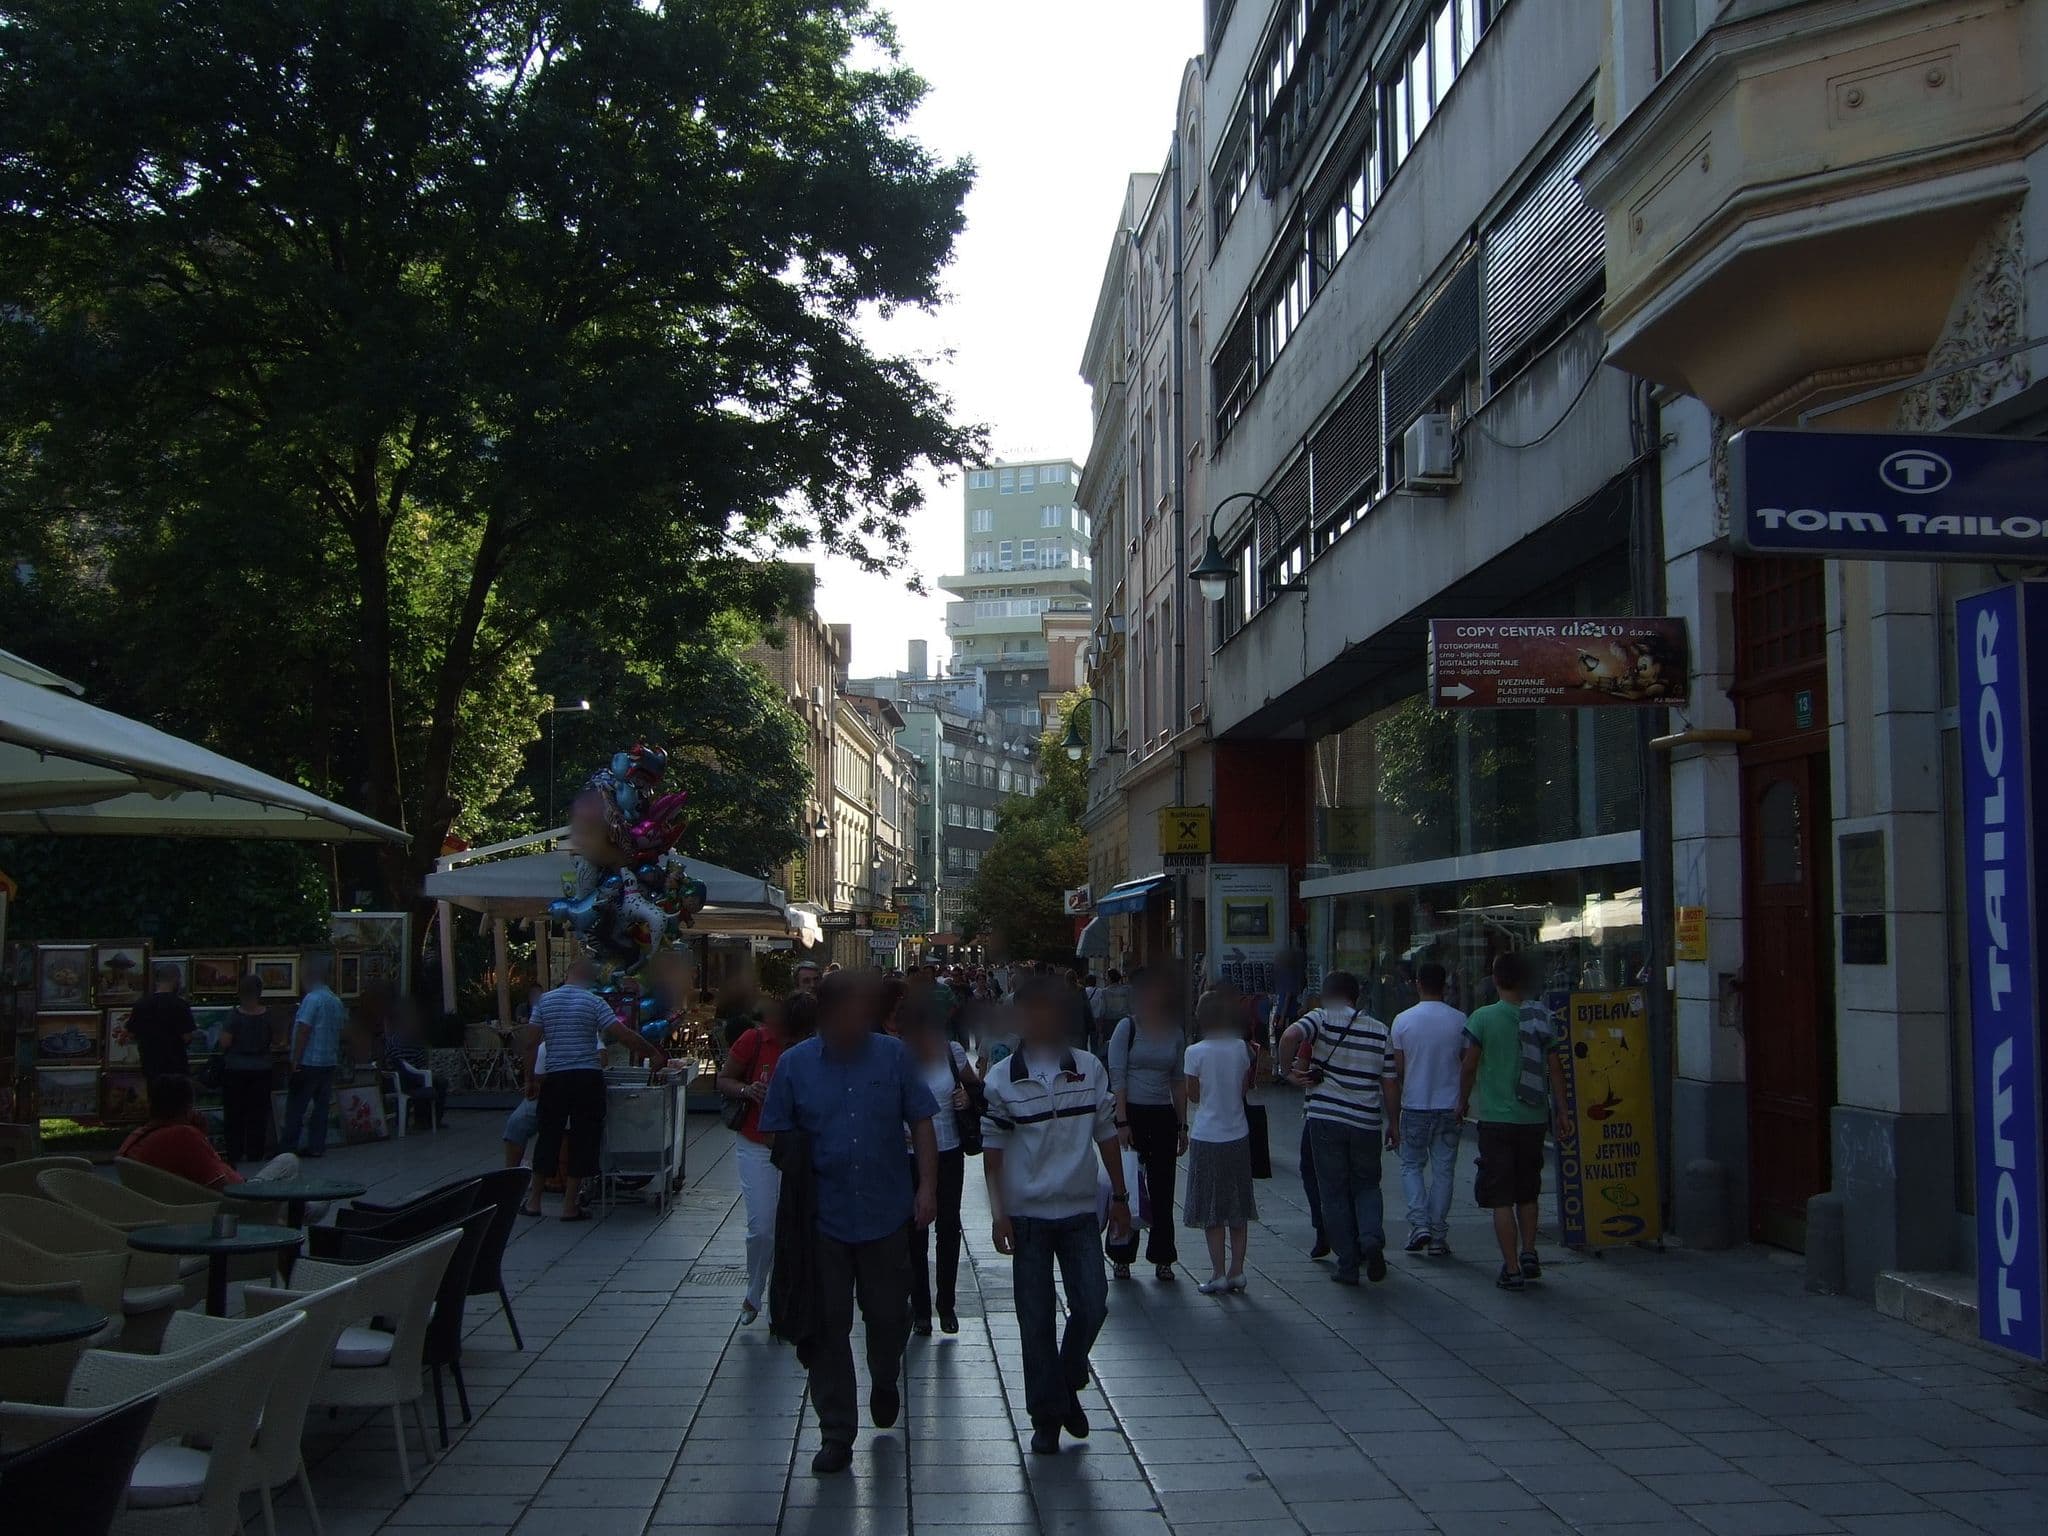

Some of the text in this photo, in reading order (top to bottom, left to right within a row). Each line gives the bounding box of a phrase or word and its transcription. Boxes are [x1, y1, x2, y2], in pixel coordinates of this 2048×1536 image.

[1895, 459, 1936, 485] T
[1756, 508, 1888, 533] TOM
[1456, 626, 1495, 637] COPY
[1500, 626, 1556, 637] CENTAR
[1177, 842, 1199, 850] BANK
[1975, 608, 2023, 1336] TOM TAILOR
[1603, 1123, 1633, 1139] BRZO
[1595, 1142, 1641, 1160] JEFTINO
[1585, 1161, 1638, 1180] KVALITET
